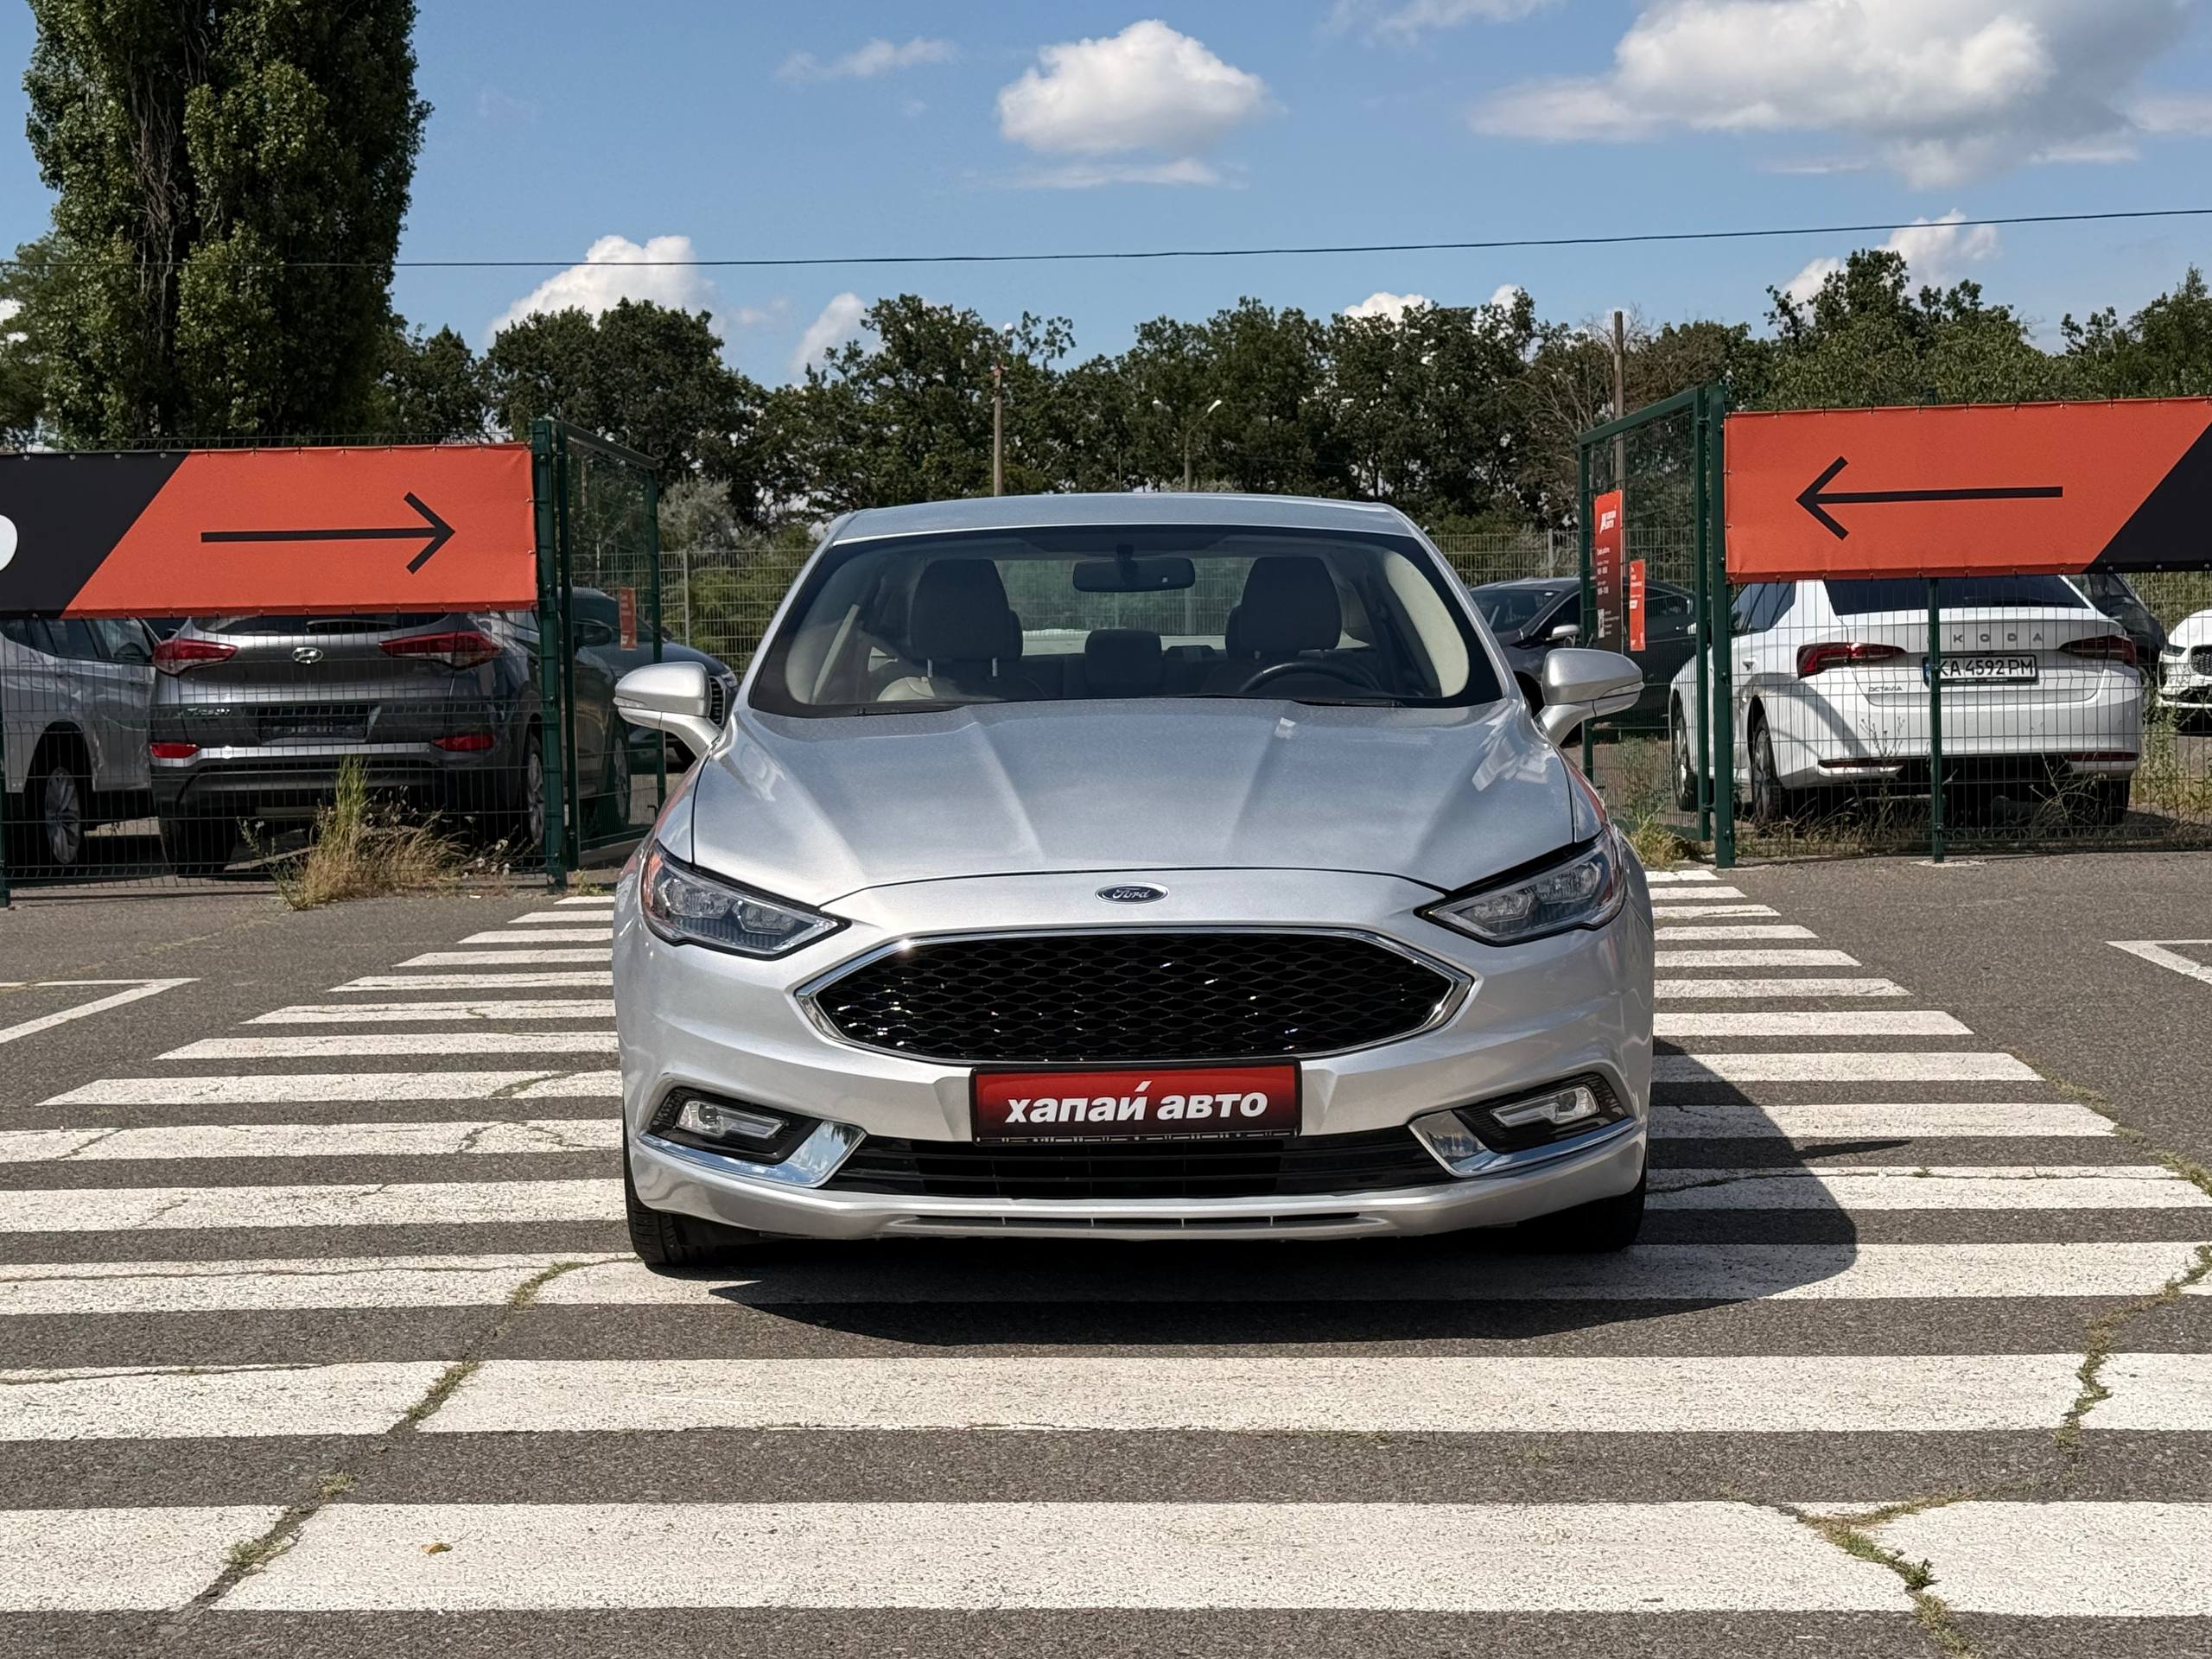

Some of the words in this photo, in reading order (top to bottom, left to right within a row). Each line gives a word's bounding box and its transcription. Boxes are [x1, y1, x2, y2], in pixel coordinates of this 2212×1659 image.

[1927, 632, 2042, 644] KODA
[1965, 659, 2005, 676] 4592
[2008, 658, 2033, 675] PM
[1112, 887, 1151, 899] Ford
[1157, 1092, 1268, 1119] авто
